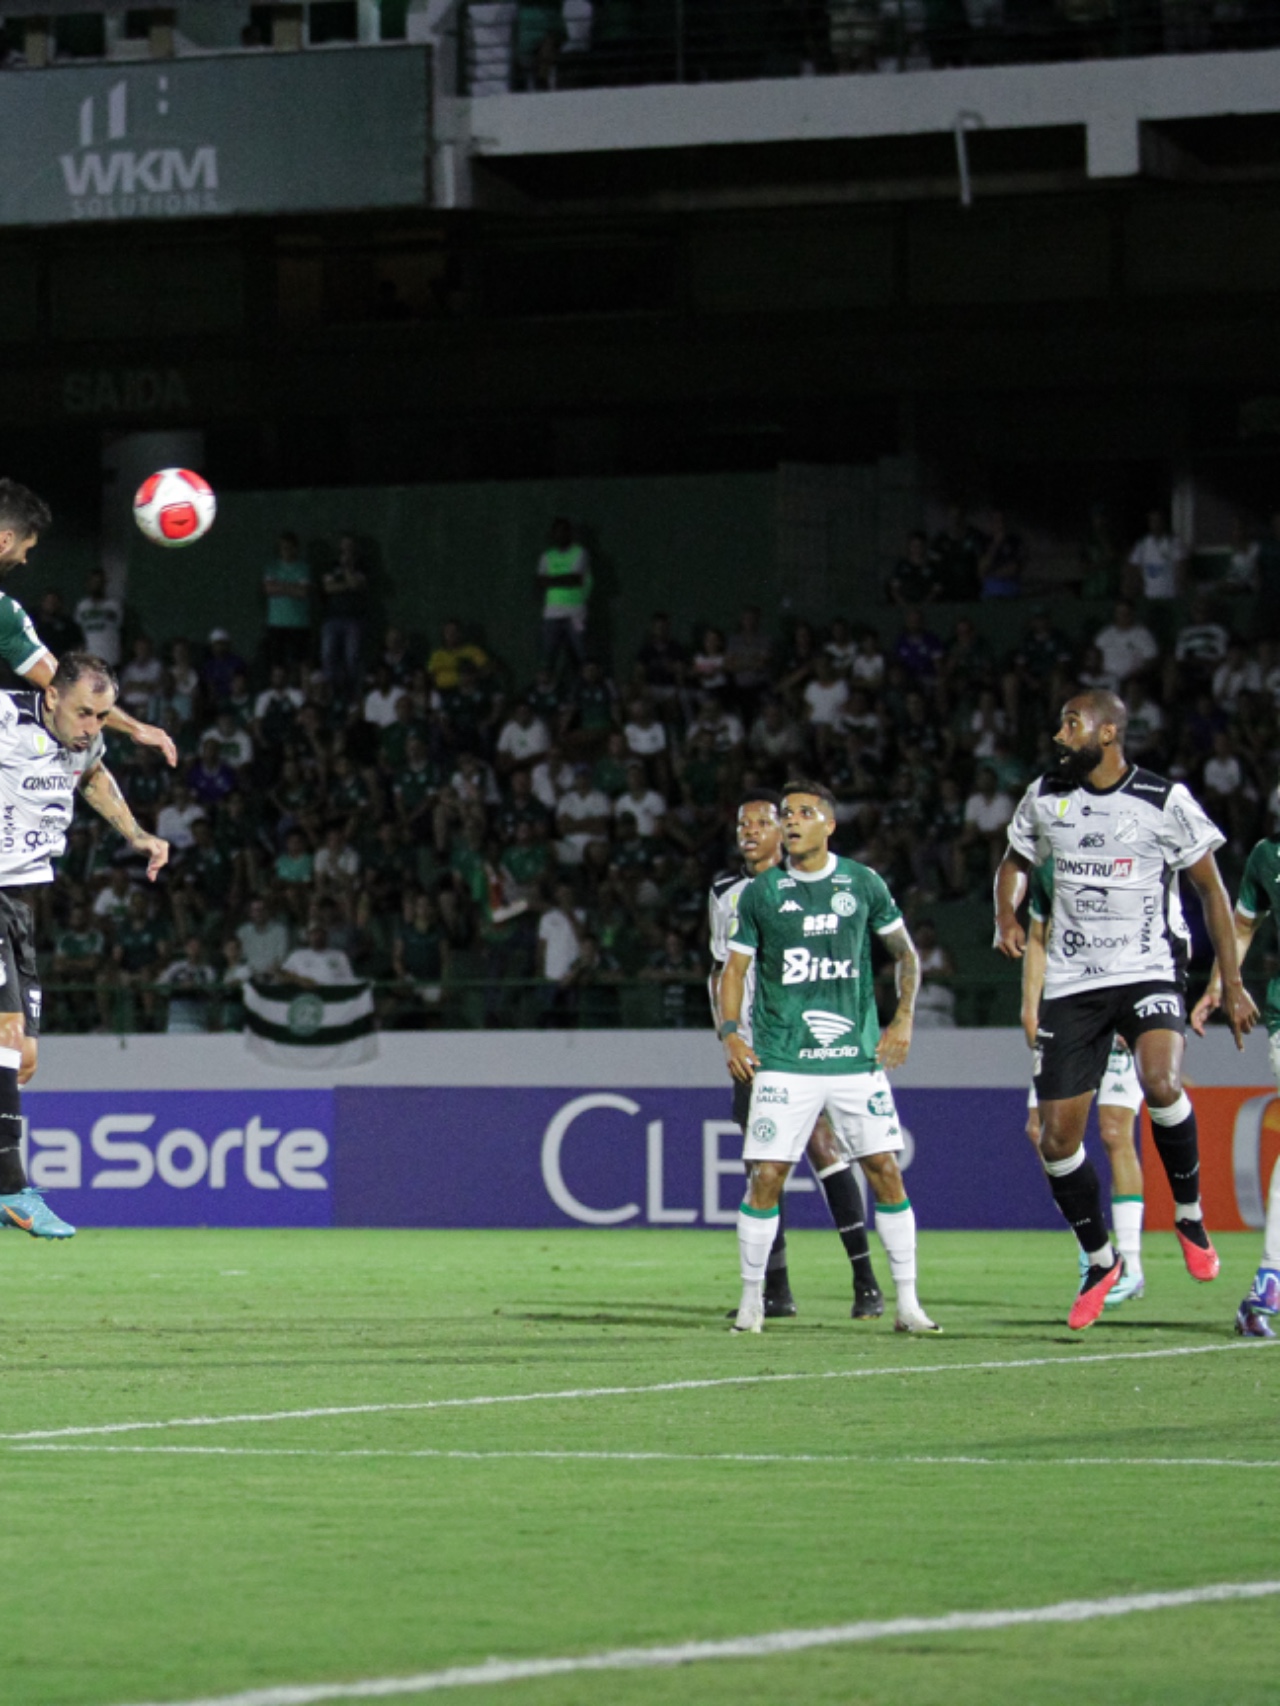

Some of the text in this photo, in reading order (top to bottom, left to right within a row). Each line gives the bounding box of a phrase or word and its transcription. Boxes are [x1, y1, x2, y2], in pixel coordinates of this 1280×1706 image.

[58, 145, 219, 196] WKM
[22, 774, 73, 792] CONSTRU
[91, 1113, 329, 1190] Sorte
[540, 1093, 916, 1225] CLE
